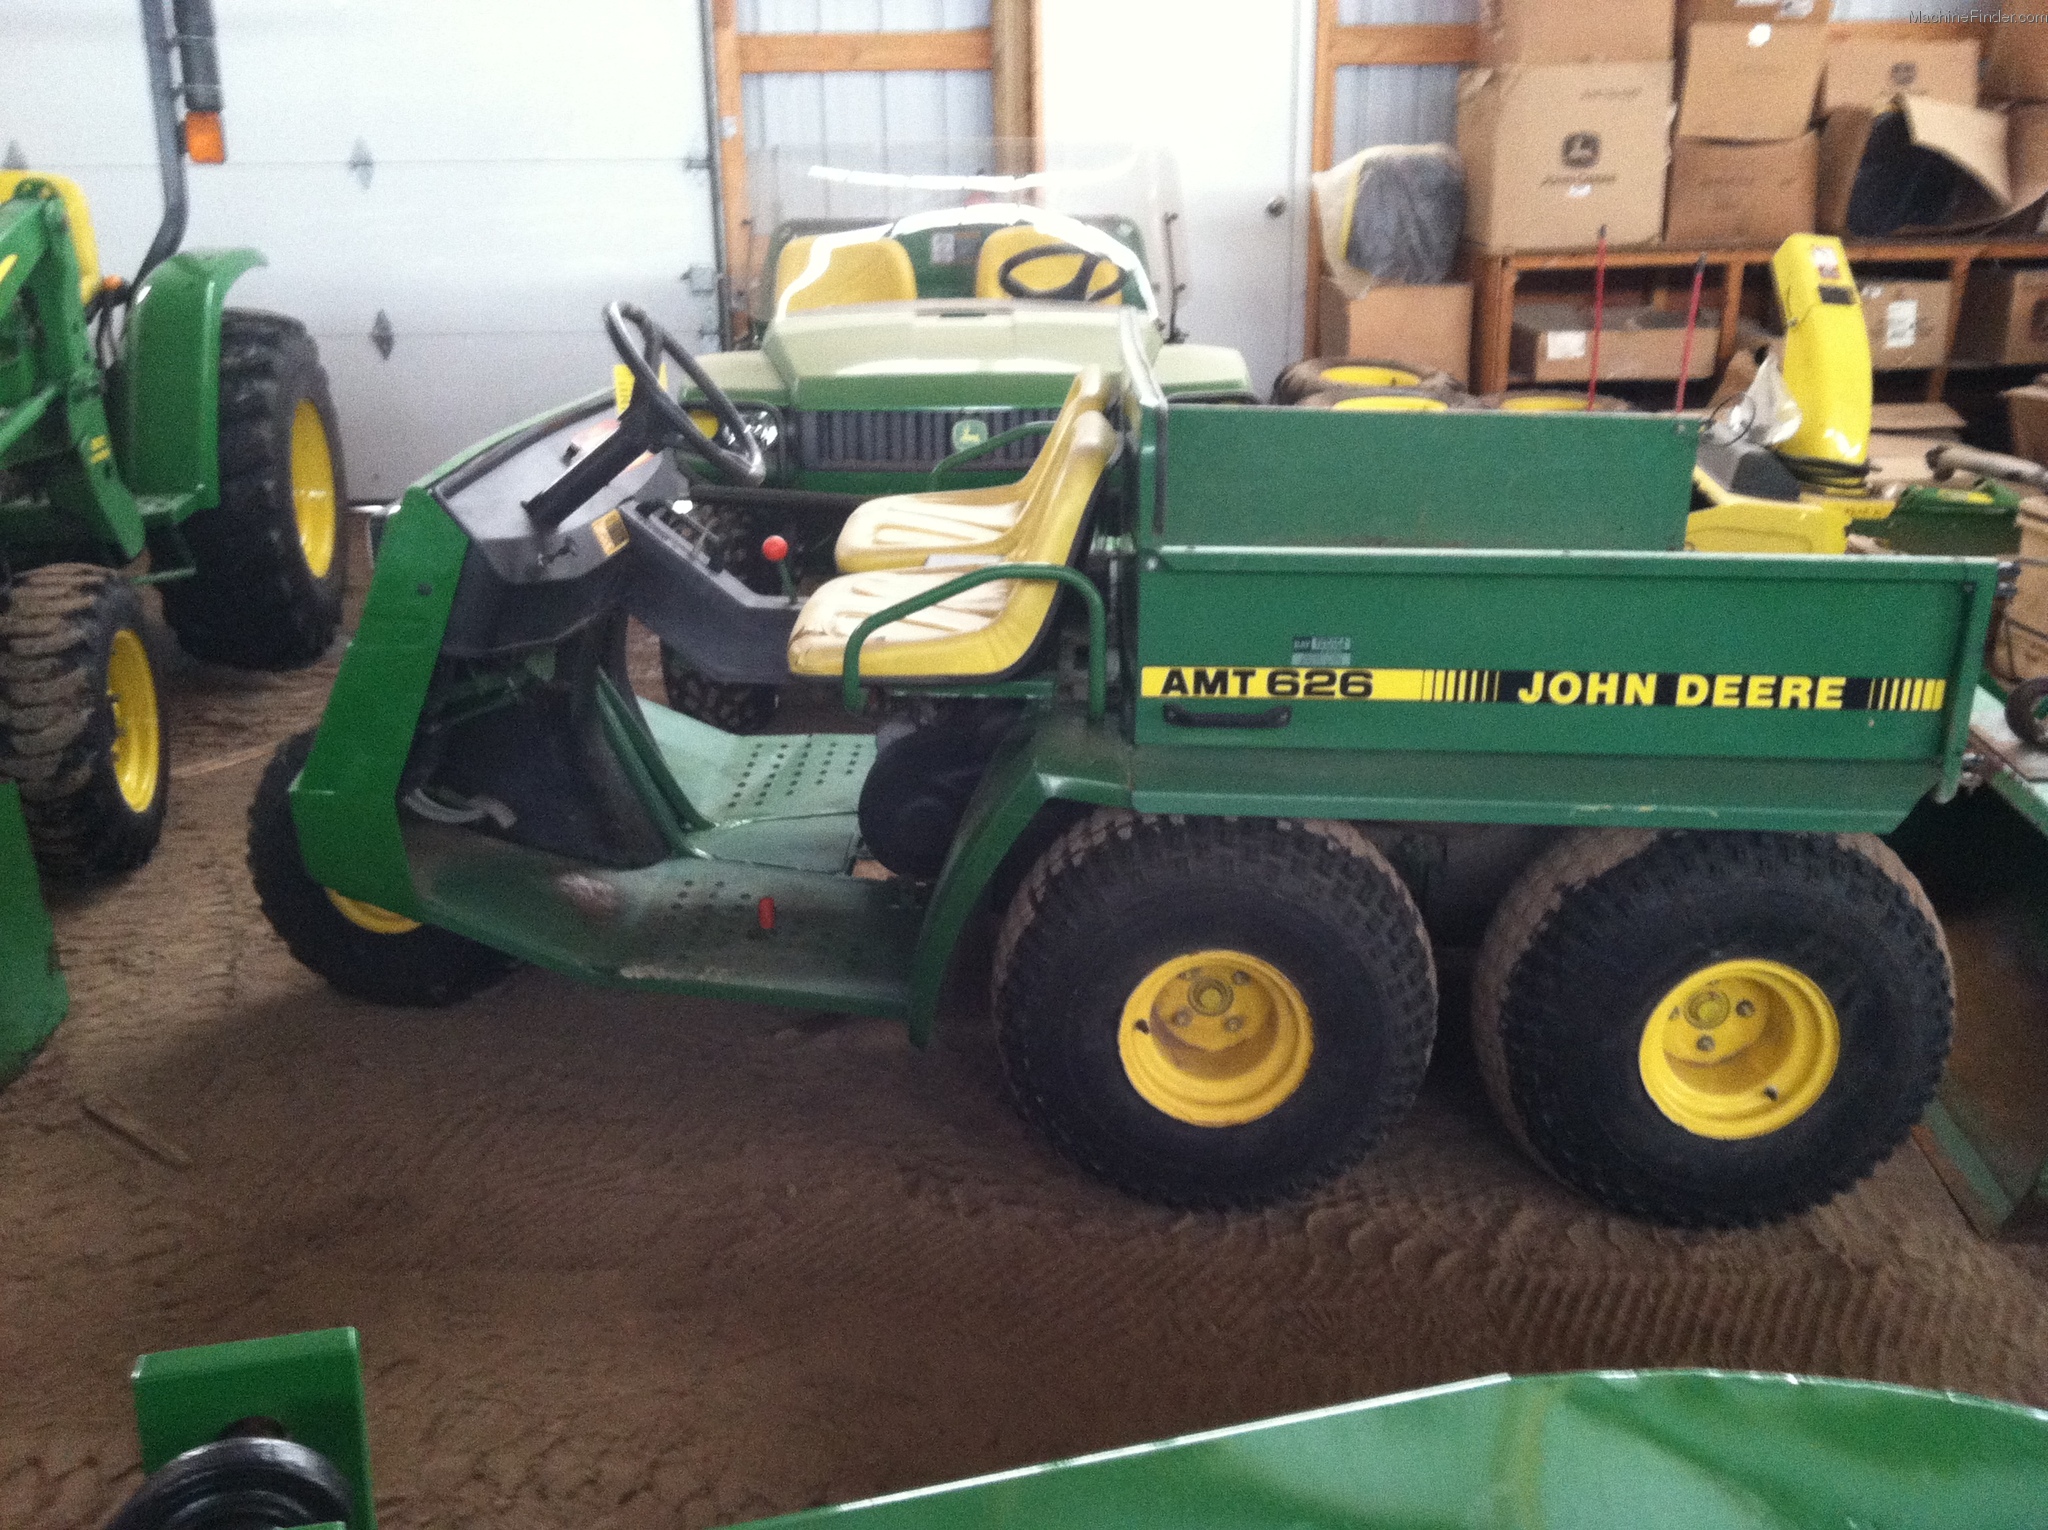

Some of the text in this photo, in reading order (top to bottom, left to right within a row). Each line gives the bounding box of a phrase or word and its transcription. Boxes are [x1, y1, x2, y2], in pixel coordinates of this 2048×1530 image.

[1161, 668, 1374, 698] AMT 626
[1518, 671, 1847, 709] JOHN DEERE
